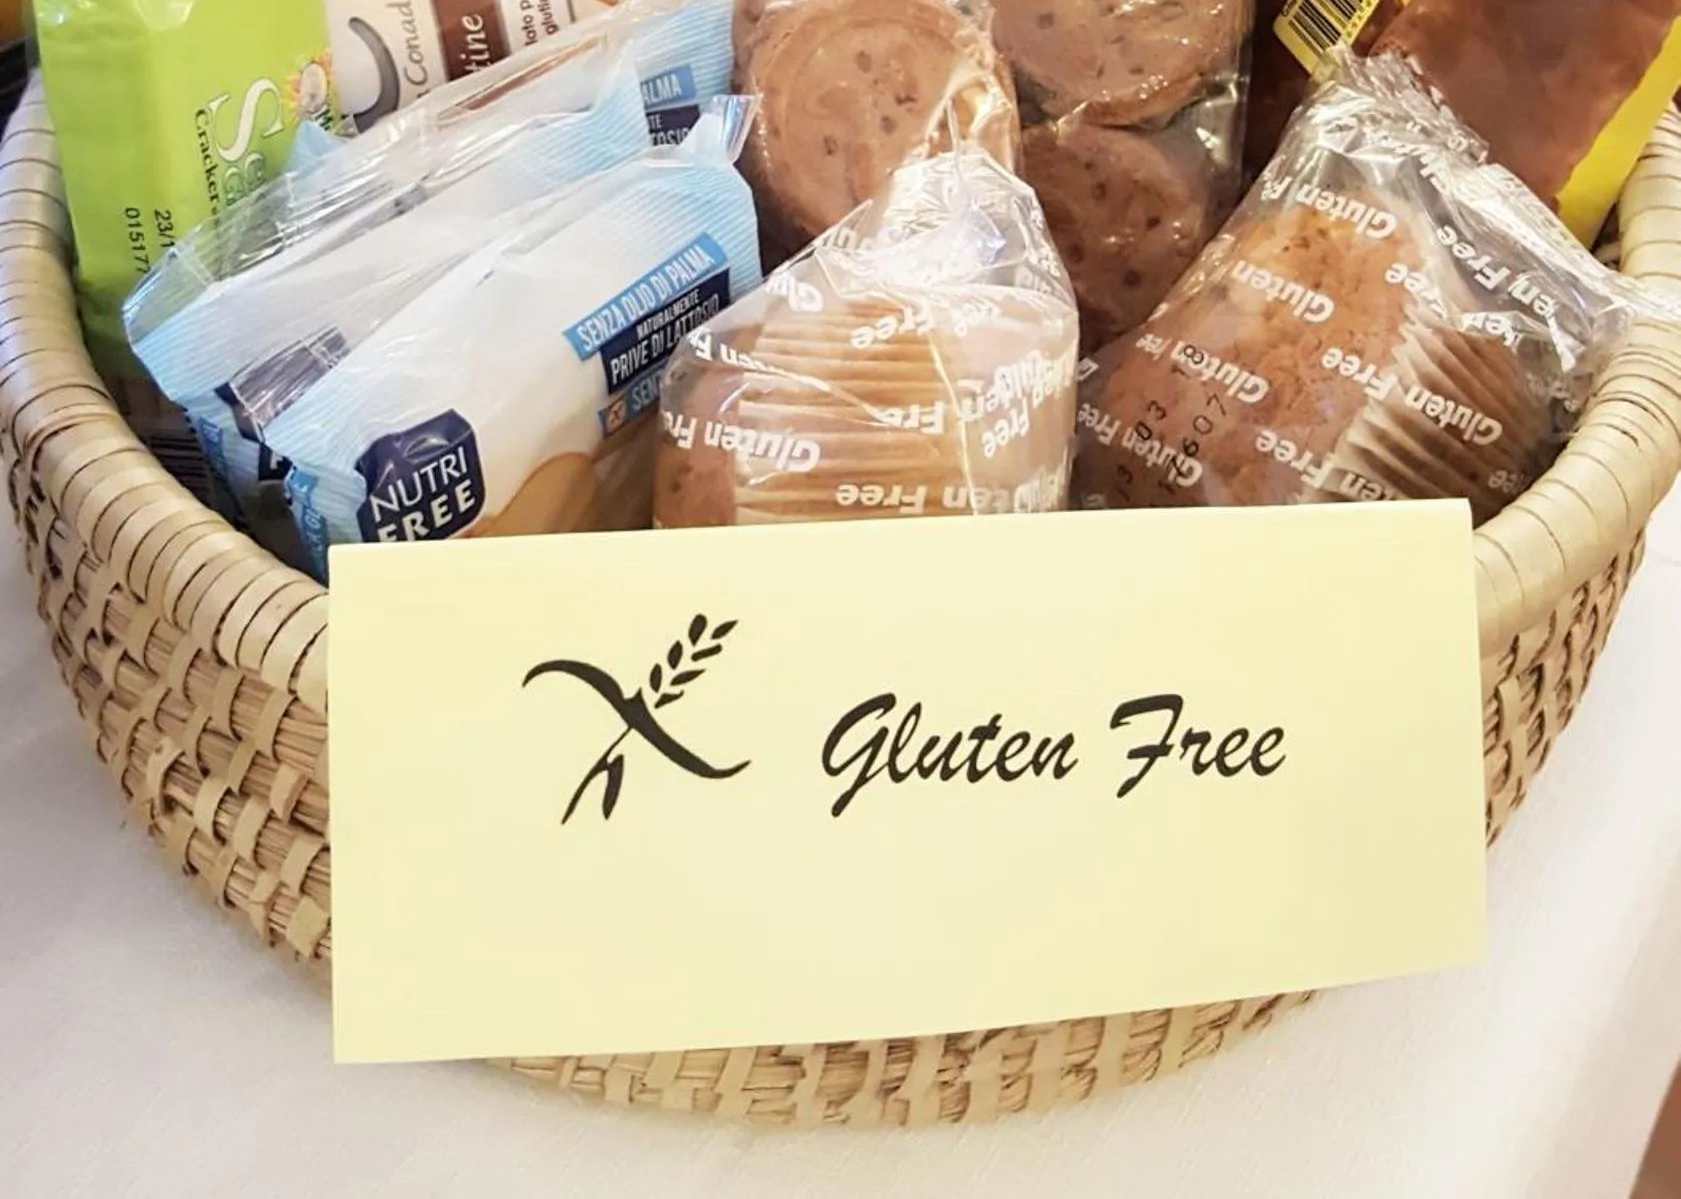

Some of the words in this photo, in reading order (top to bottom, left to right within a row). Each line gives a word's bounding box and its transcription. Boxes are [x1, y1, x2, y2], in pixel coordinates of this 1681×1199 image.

[386, 0, 429, 86] Conad
[1295, 182, 1398, 240] Gluten
[1437, 224, 1512, 291] Free
[576, 304, 628, 352] SENZA
[623, 282, 657, 320] OLIO
[649, 275, 670, 299] DI
[665, 243, 717, 290] PALMA
[635, 287, 702, 339] NATURALMENTE
[1230, 259, 1336, 324] Gluten
[610, 340, 650, 386] PRIVE
[651, 333, 666, 359] DI
[1321, 346, 1399, 402] Free
[704, 420, 822, 473] Gluten
[981, 397, 1030, 460] Free
[1077, 401, 1123, 447] Free
[1405, 384, 1504, 447] Gluten
[369, 445, 468, 524] NUTRI
[1120, 426, 1203, 488] Gluten
[1254, 429, 1335, 490] Free
[376, 478, 476, 542] FREE
[835, 483, 929, 515] Free
[821, 692, 1079, 818] Gluten
[1109, 693, 1287, 799] Free
